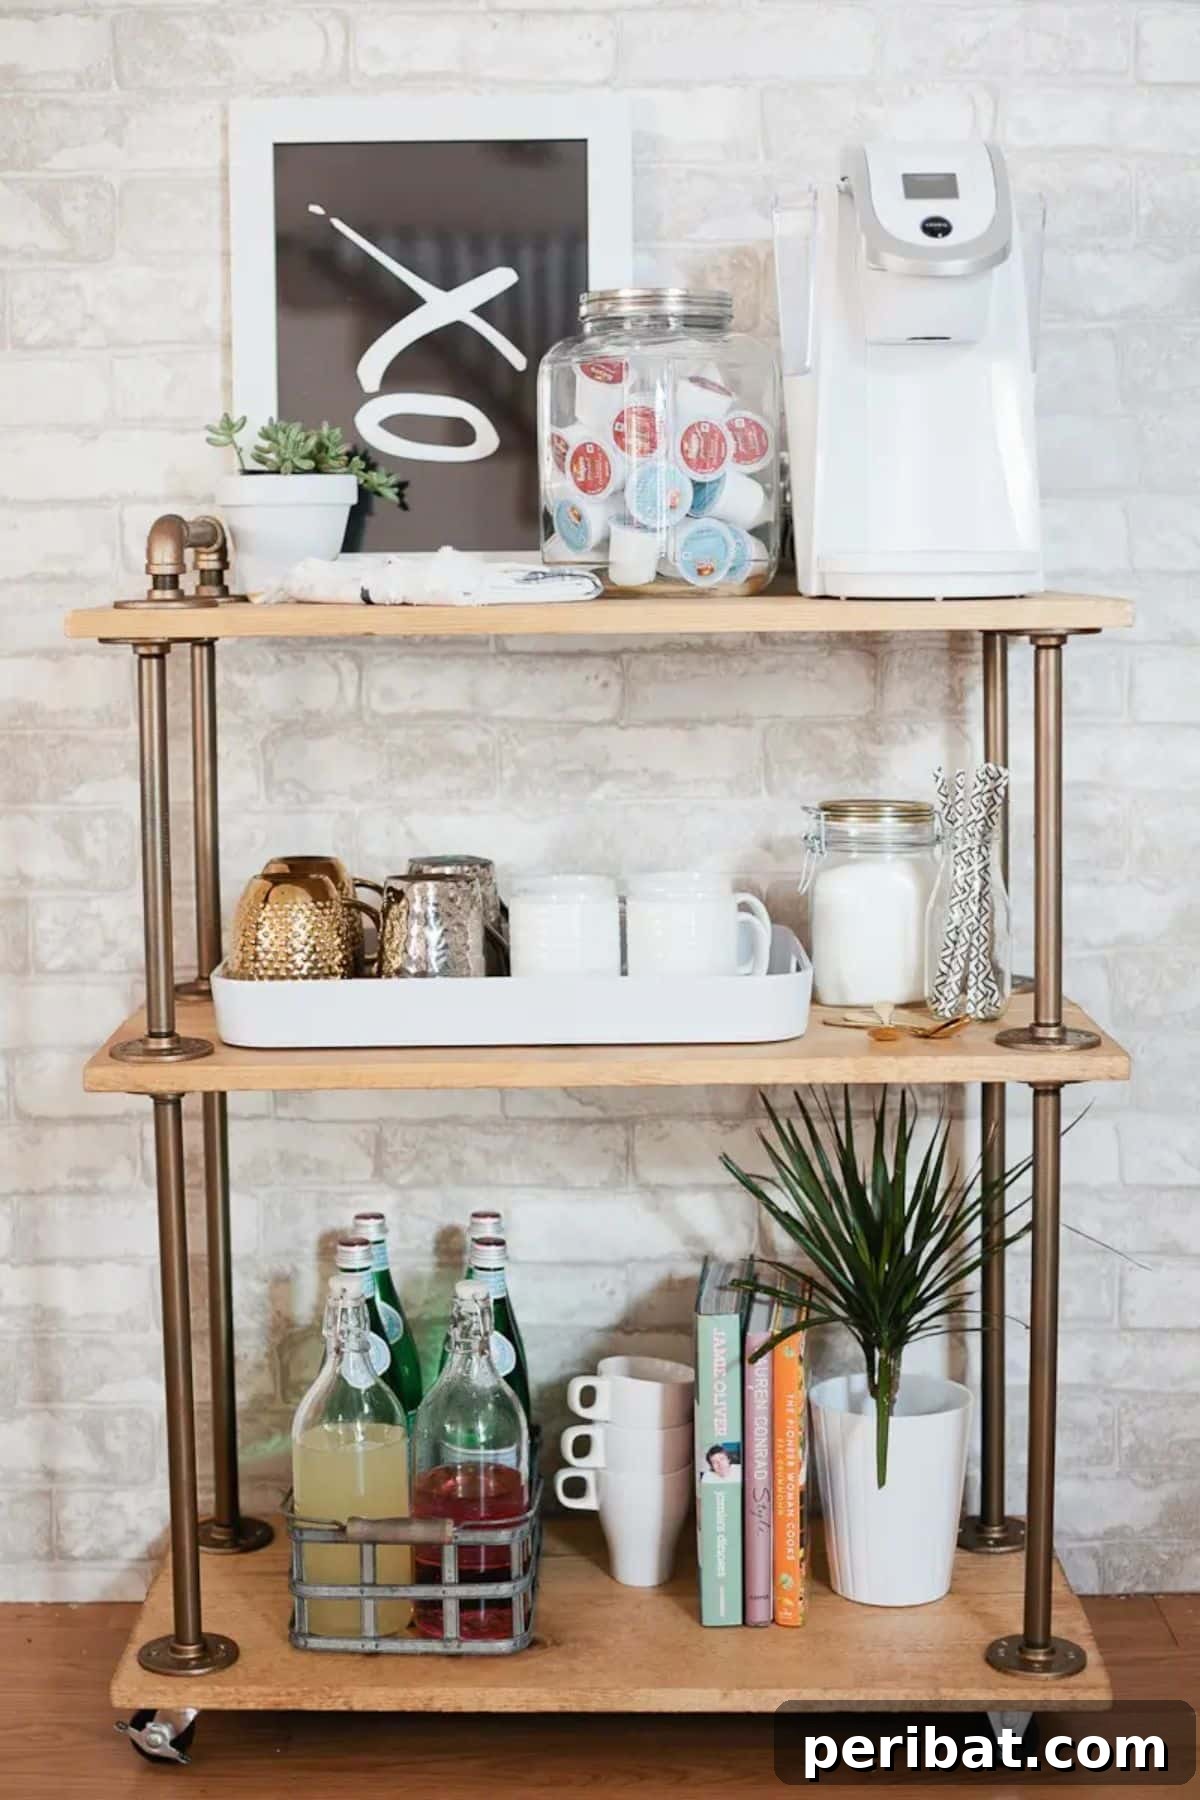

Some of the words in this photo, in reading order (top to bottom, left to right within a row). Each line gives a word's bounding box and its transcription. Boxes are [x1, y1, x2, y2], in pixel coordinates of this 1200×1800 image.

[713, 1328, 729, 1378] JAMIE
[713, 1380, 729, 1437] OLIVER
[786, 1393, 796, 1414] THE
[753, 1415, 769, 1481] CONRAD
[786, 1472, 796, 1518] WOMAN
[786, 1522, 796, 1562] COOKS
